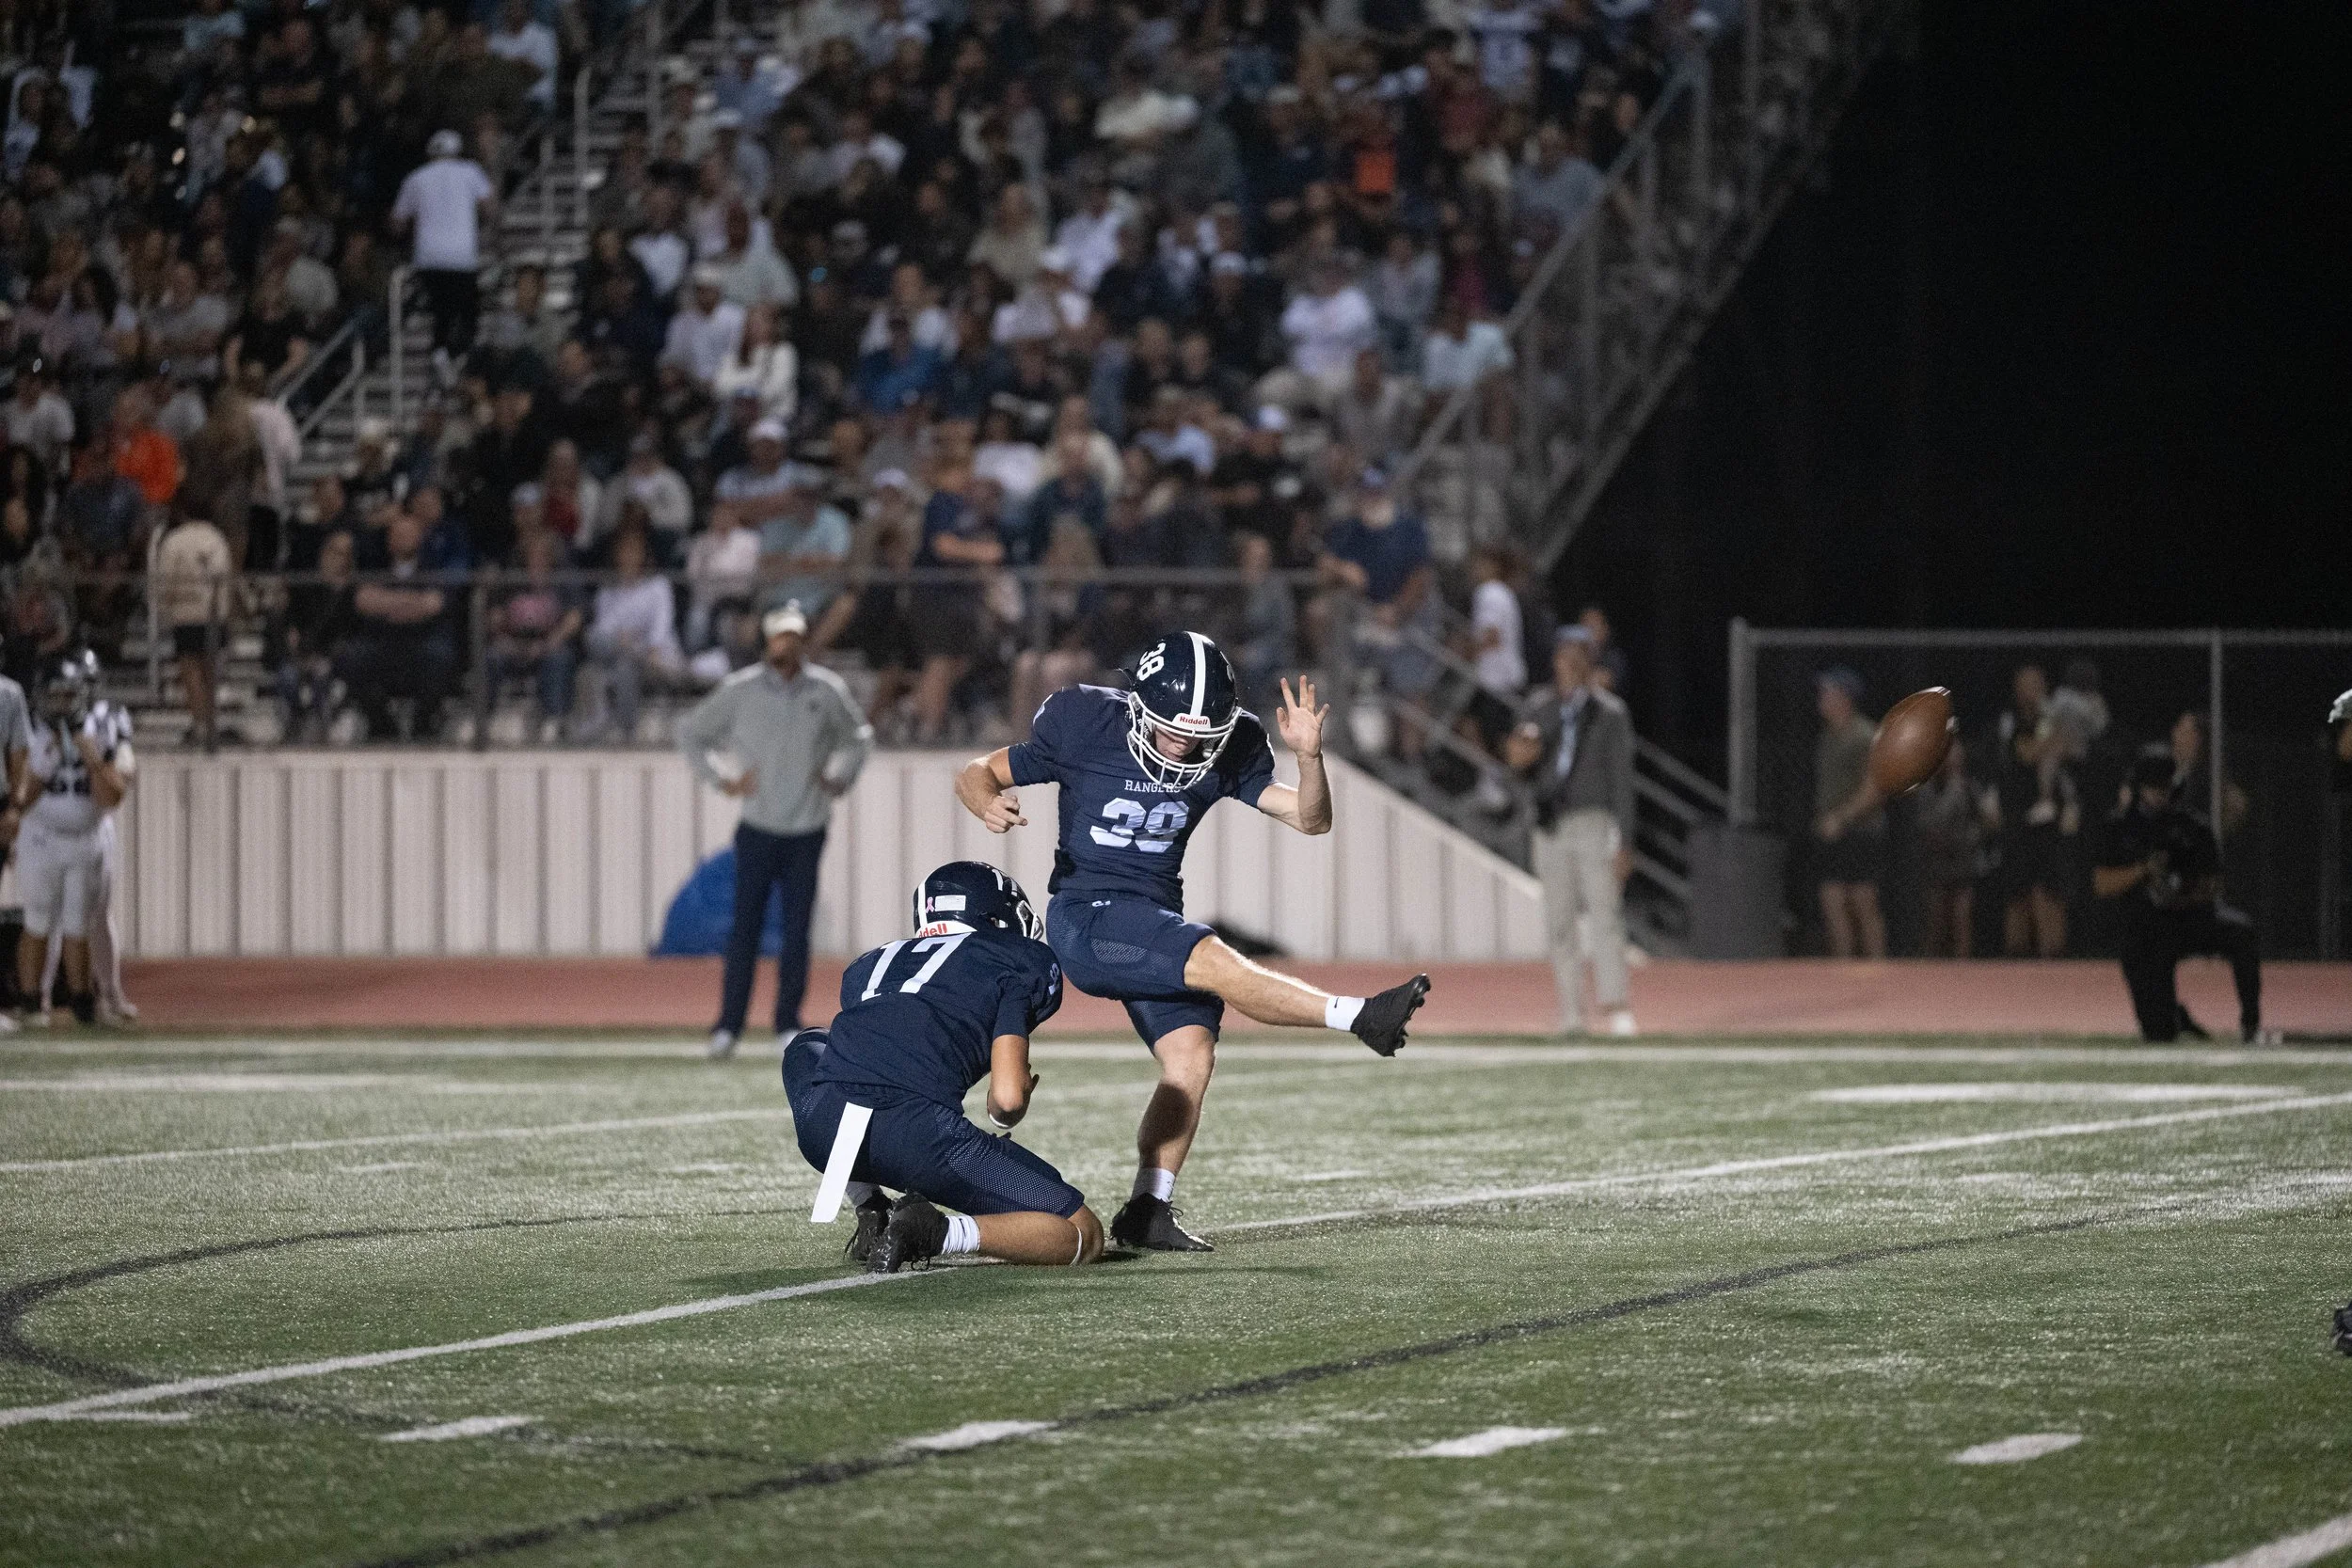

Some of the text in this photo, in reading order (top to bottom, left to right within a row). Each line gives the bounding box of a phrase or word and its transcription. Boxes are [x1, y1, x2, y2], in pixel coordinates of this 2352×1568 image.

[1136, 642, 1167, 682] 38
[1179, 716, 1209, 726] Riddell
[1089, 798, 1190, 853] 38
[919, 923, 948, 939] ddell
[861, 932, 973, 1002] 17
